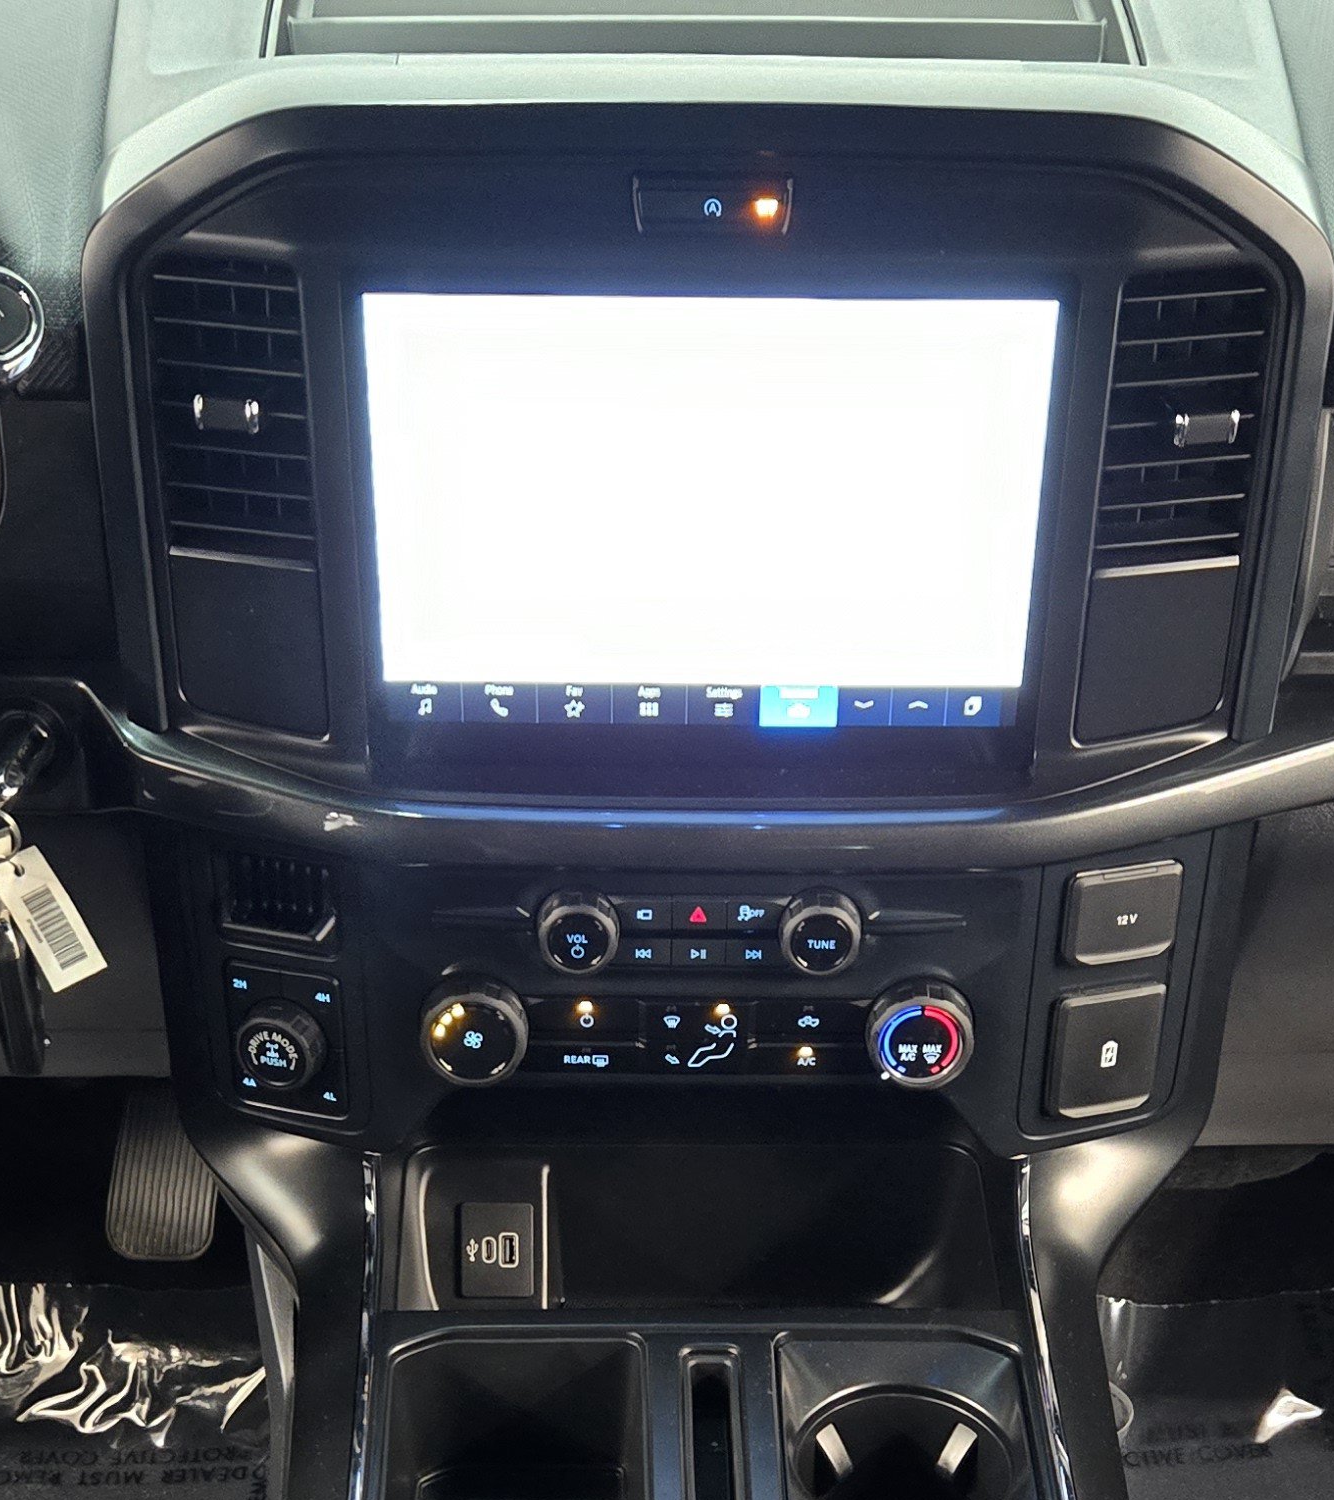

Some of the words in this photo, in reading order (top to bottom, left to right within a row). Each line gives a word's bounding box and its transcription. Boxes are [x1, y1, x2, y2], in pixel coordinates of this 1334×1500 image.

[750, 908, 765, 918] OFF
[567, 934, 588, 944] VOL
[807, 939, 836, 950] TUNE
[233, 978, 247, 989] 2H
[314, 992, 331, 1003] 4H
[248, 1031, 270, 1054] DRIVE
[271, 1032, 299, 1060] MODE
[898, 1044, 917, 1053] MAX
[922, 1044, 942, 1053] MAX
[260, 1055, 287, 1068] PUSH
[564, 1054, 591, 1065] REAR
[797, 1055, 816, 1066] A/C
[900, 1052, 917, 1062] A/C
[243, 1077, 257, 1087] 4A
[323, 1091, 337, 1102] 4L
[77, 1470, 143, 1486] MUST
